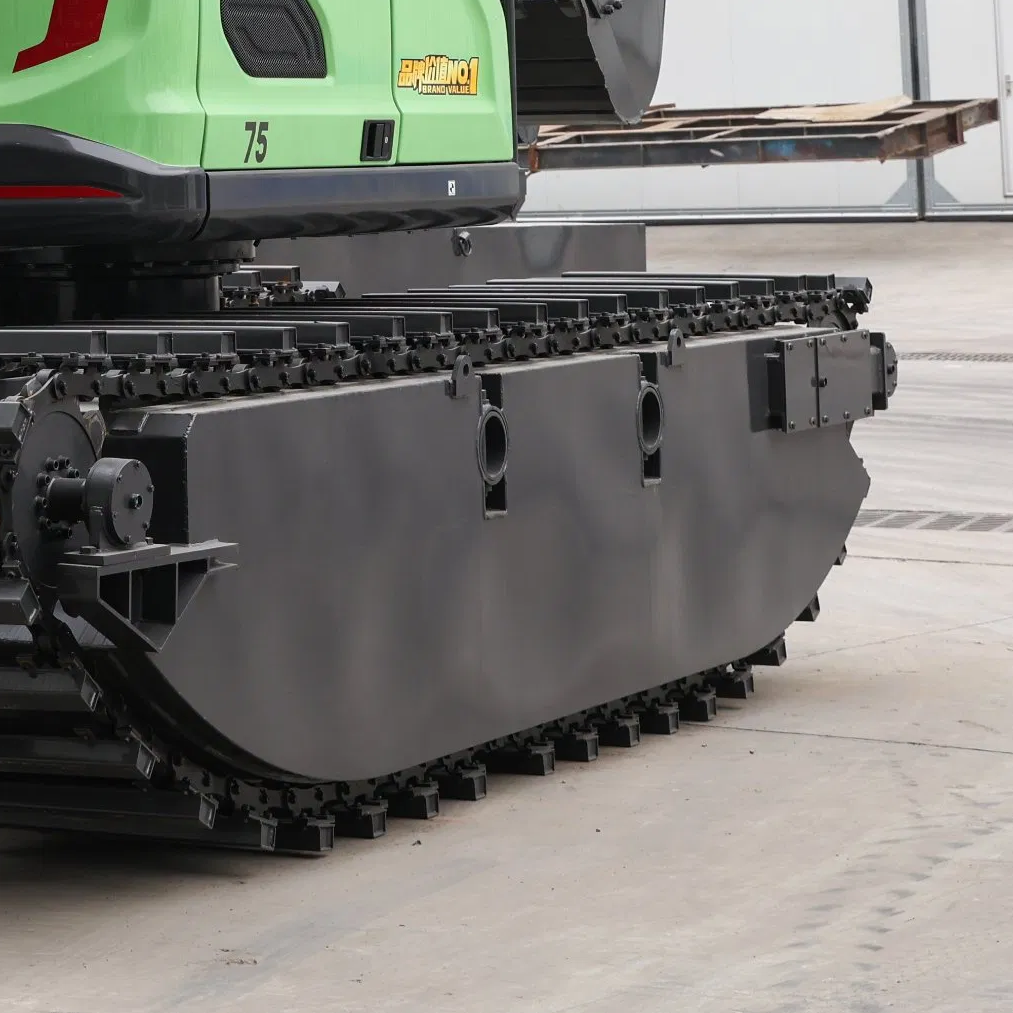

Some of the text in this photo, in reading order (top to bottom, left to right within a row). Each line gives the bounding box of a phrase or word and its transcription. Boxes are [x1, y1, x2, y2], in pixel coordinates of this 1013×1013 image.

[422, 84, 470, 95] BRAND VALUE
[243, 121, 269, 164] 75
